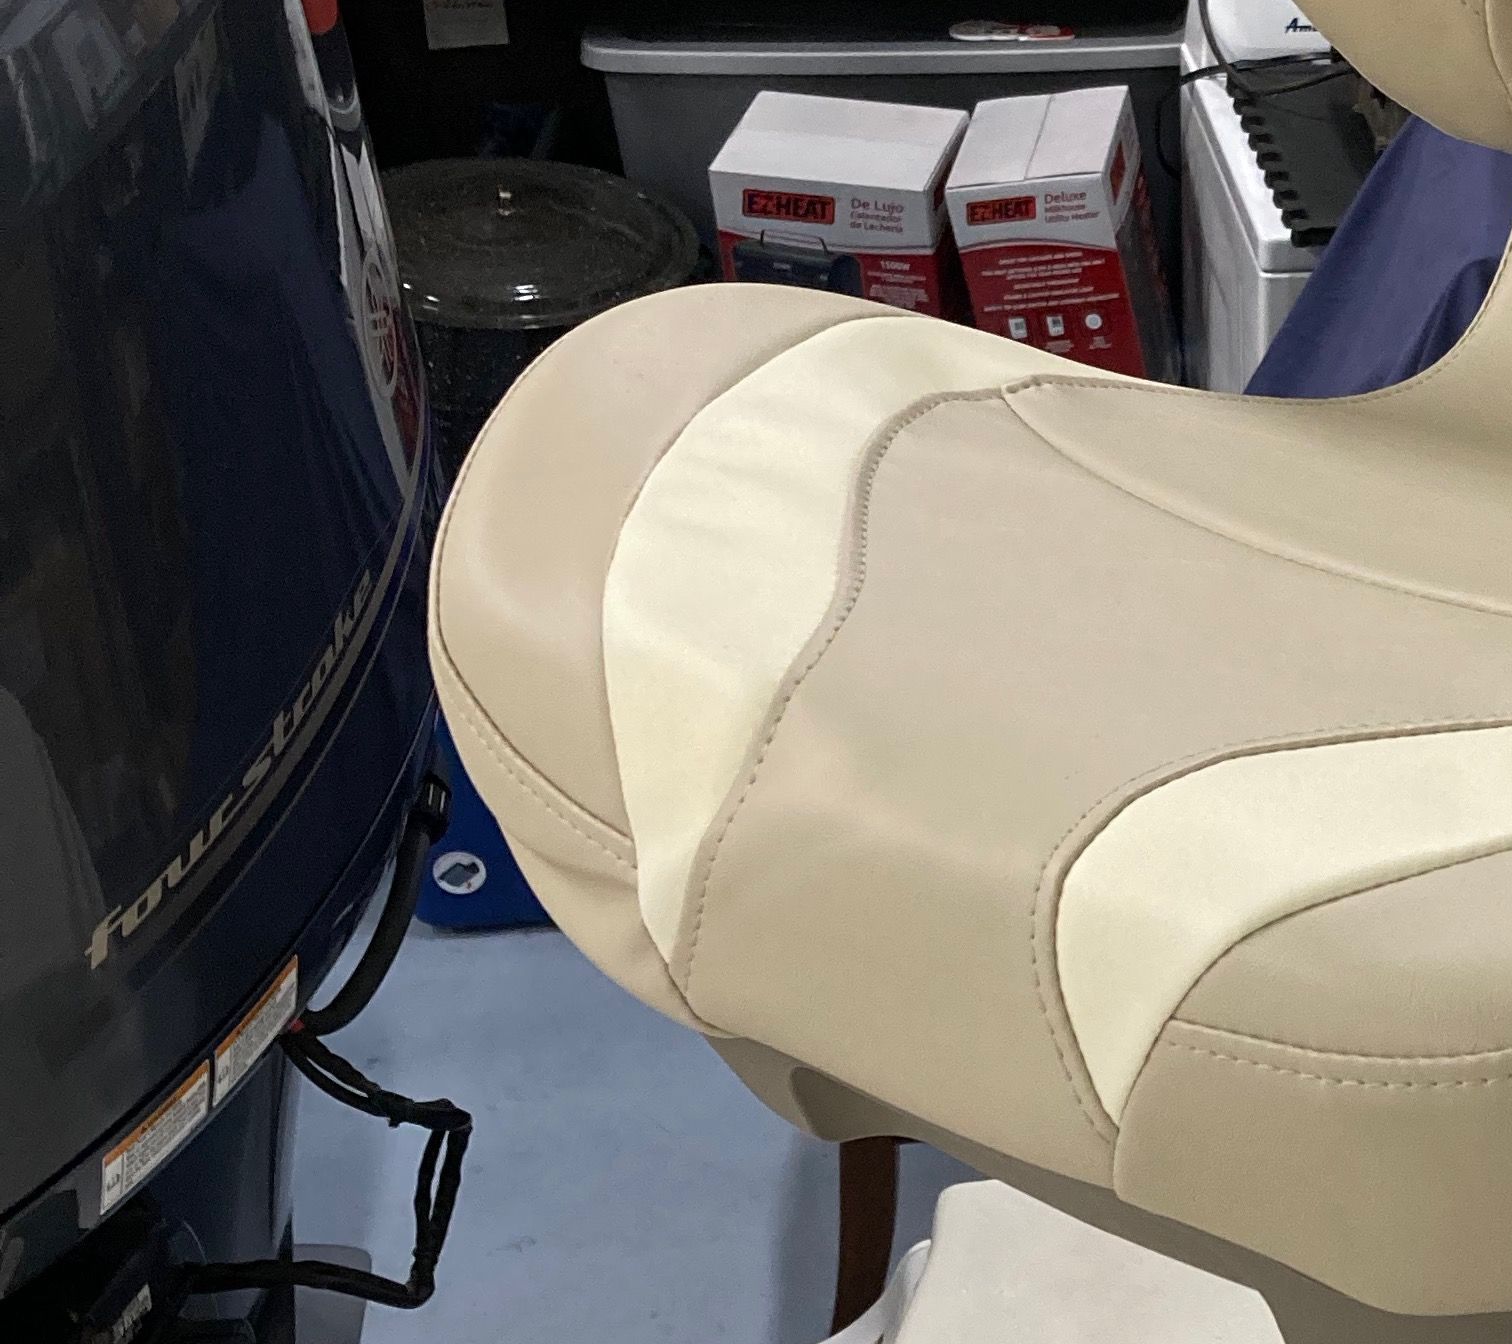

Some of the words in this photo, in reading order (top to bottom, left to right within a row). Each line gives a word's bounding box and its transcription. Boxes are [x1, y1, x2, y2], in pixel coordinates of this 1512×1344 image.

[851, 197, 870, 210] De
[874, 199, 905, 215] Lujo
[1044, 191, 1088, 205] Deluxe
[84, 793, 234, 970] four
[241, 568, 372, 789] stroke
